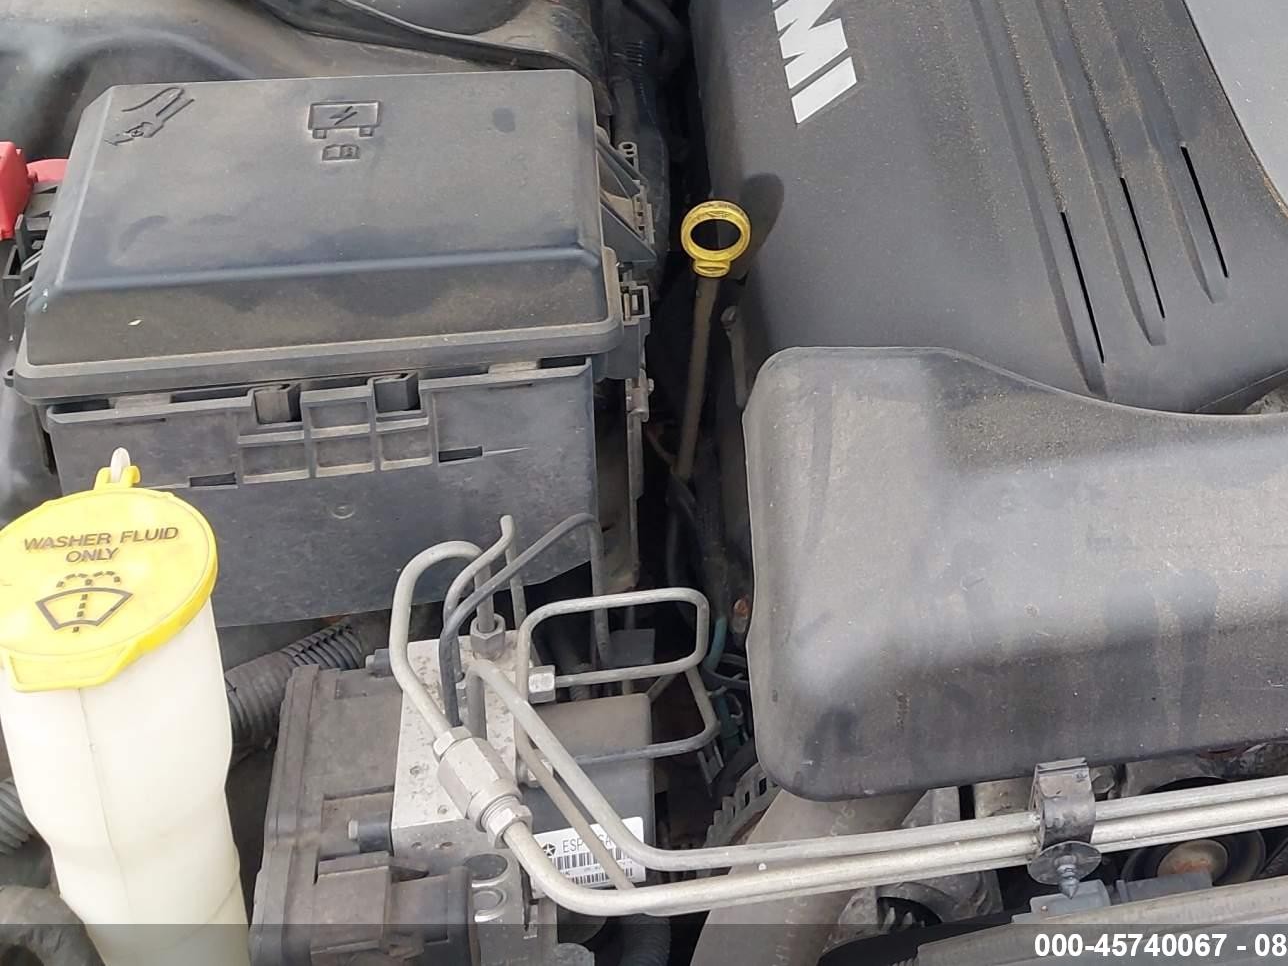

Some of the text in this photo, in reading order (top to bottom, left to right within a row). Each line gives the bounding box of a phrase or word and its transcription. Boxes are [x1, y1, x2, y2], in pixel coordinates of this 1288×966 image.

[24, 526, 179, 551] WASHER FLUID
[65, 547, 119, 563] ONLY
